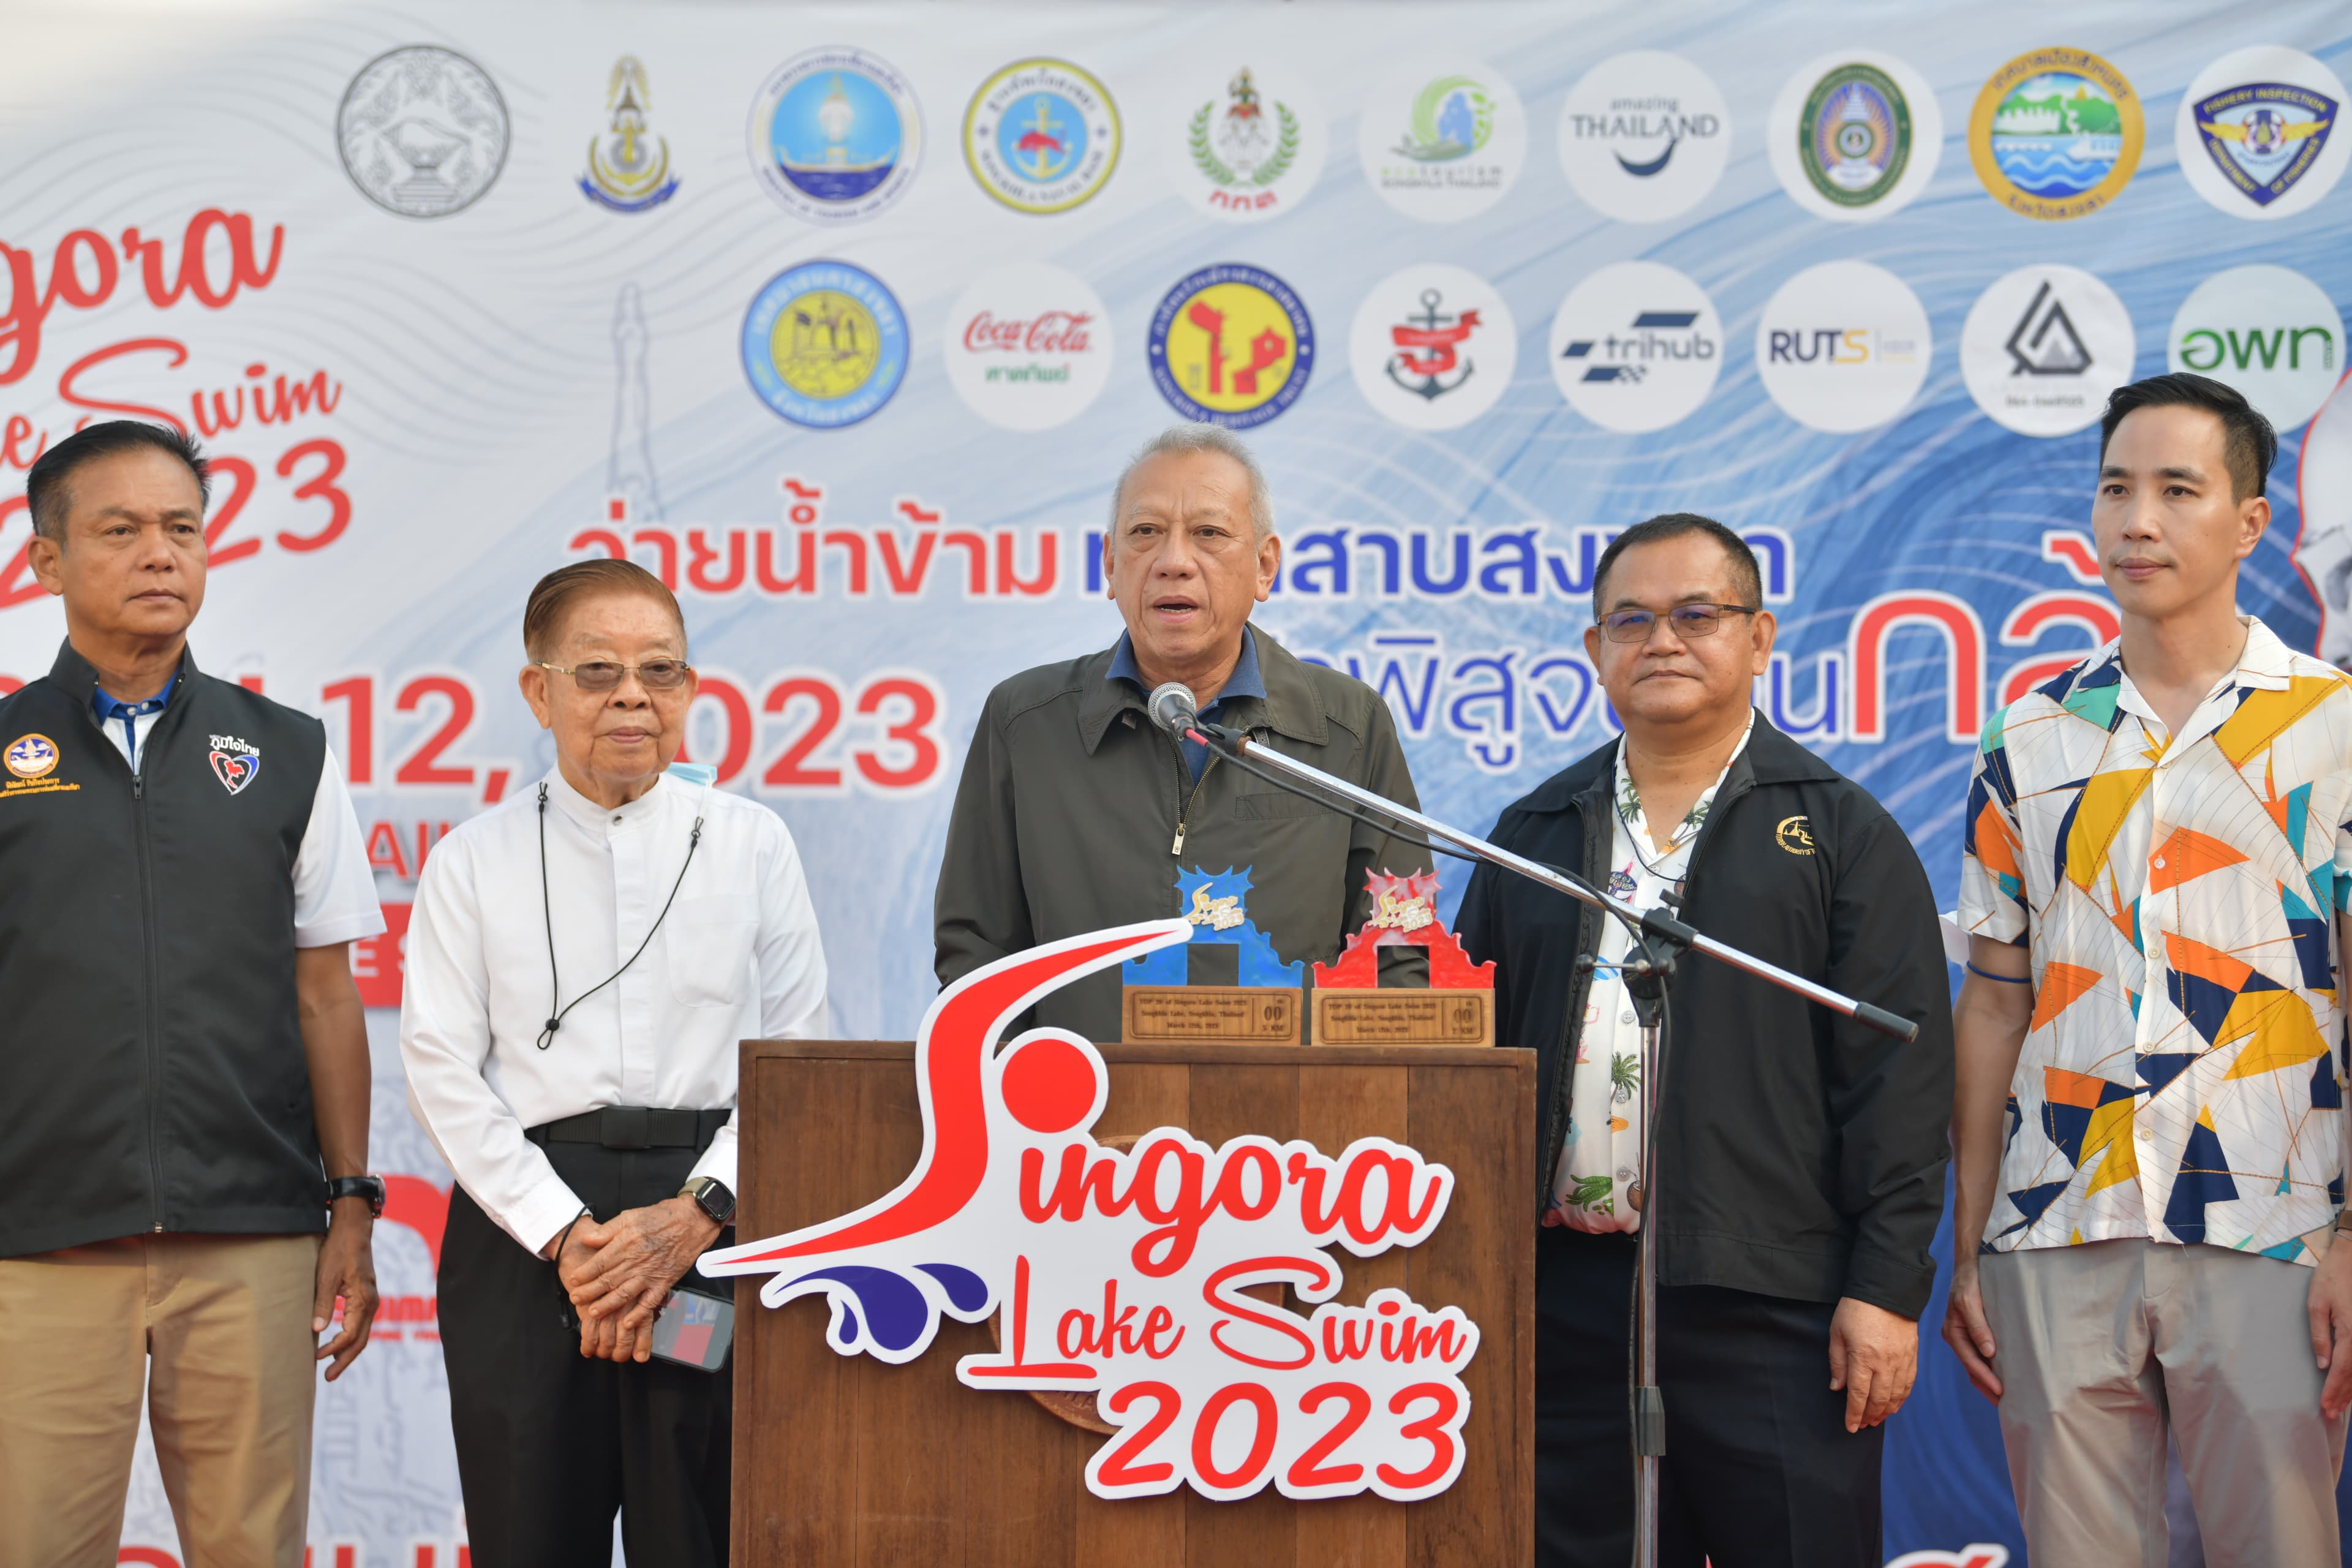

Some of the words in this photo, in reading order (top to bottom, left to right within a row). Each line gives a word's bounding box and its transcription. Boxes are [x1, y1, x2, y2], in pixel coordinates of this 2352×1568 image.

[1570, 115, 1719, 139] THAILAND
[1610, 96, 1679, 115] amazing
[963, 311, 1095, 353] Coca-Cola
[1604, 333, 1714, 361] trihub
[1770, 330, 1868, 364] RUTS
[59, 337, 342, 441] Swim
[0, 439, 352, 612] 223
[320, 674, 511, 804] 12,
[967, 1254, 1185, 1379] Lake
[1202, 1256, 1466, 1371] Swim
[1097, 1381, 1458, 1489] 2023
